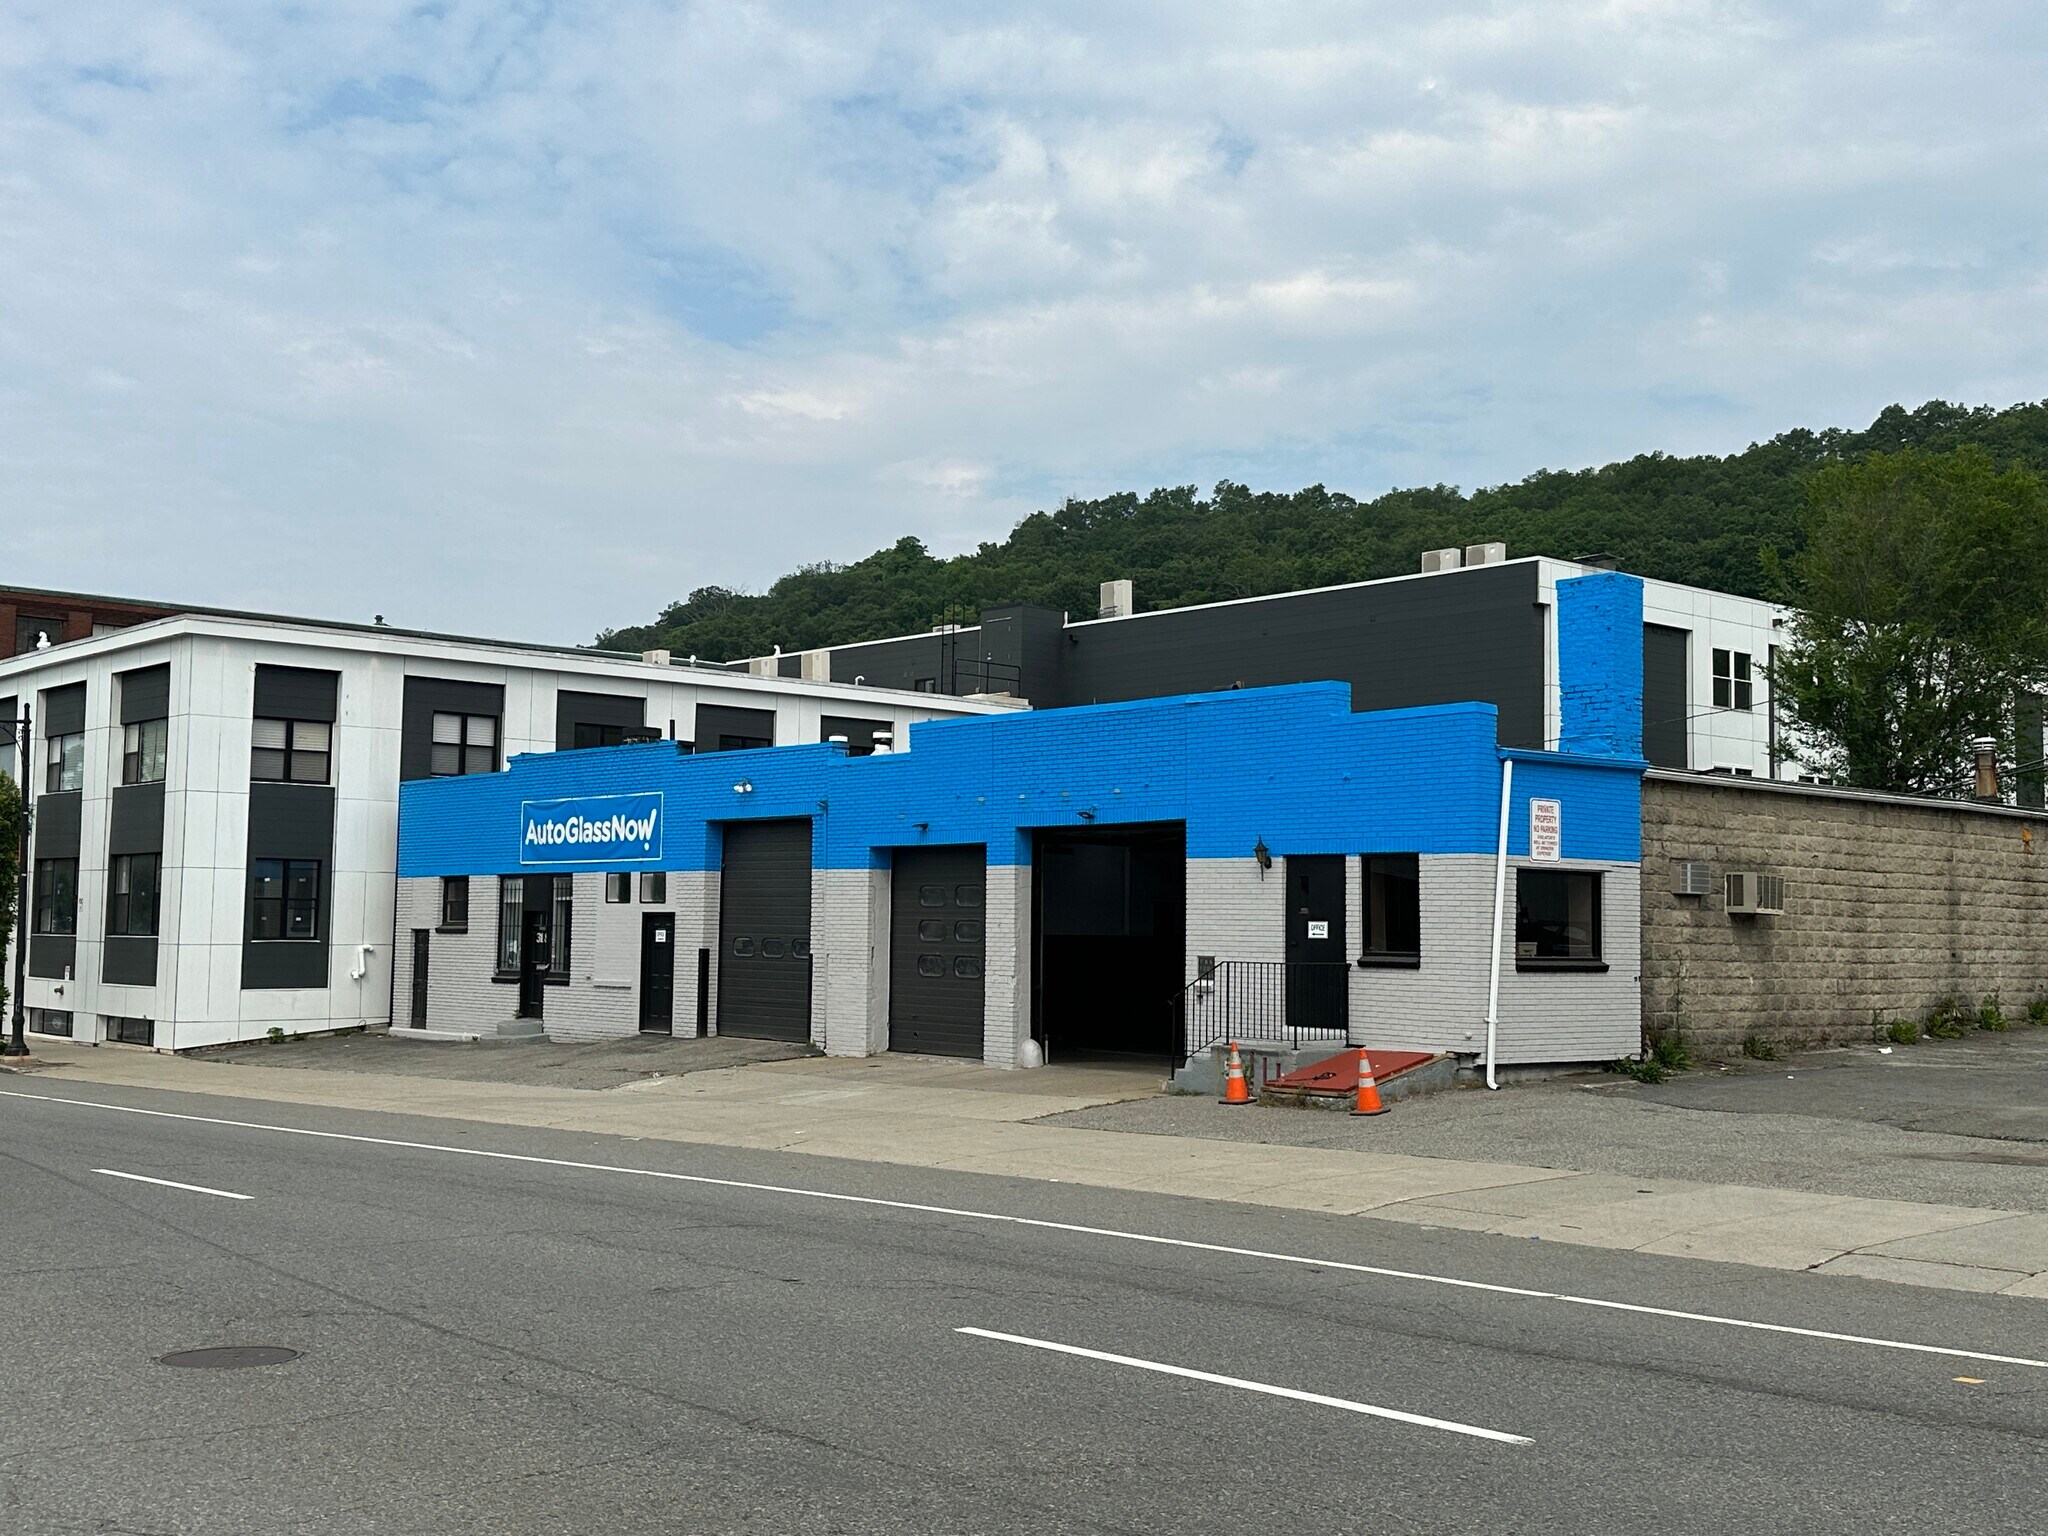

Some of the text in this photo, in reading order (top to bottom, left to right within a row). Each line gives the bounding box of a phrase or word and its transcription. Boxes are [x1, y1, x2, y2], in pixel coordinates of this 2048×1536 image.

[1537, 804, 1554, 814] PRIVATE
[1535, 814, 1557, 824] PROPERTY
[525, 808, 657, 851] AutoGlassNow!
[1533, 825, 1558, 834] NO PARKING
